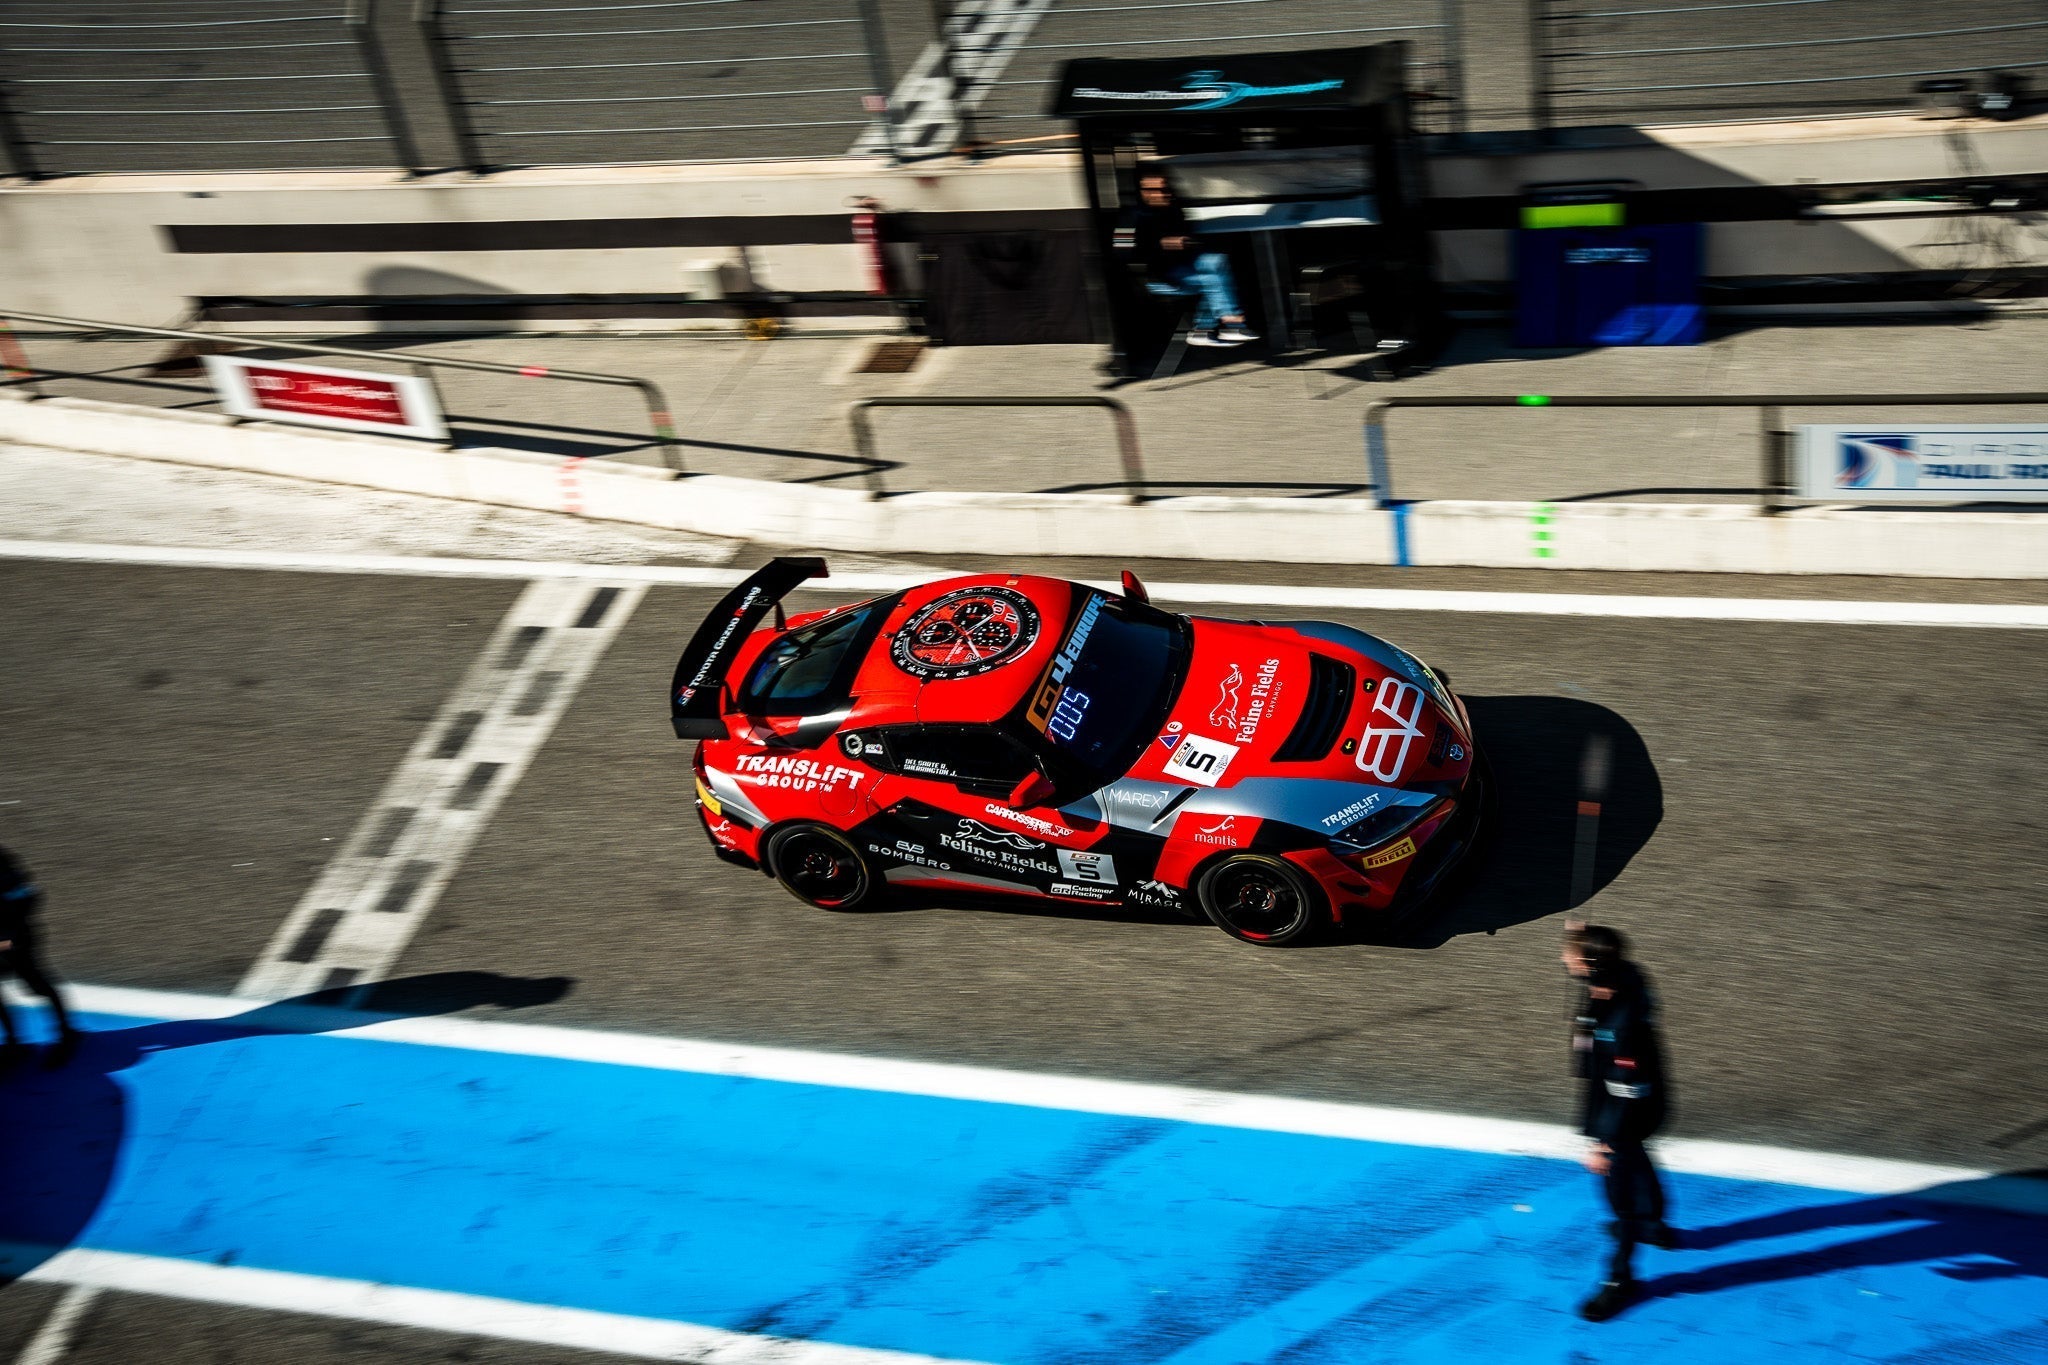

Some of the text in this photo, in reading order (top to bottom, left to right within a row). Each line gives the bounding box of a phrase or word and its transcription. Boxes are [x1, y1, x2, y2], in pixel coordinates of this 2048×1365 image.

[1064, 593, 1106, 662] EUROPE
[1048, 686, 1091, 741] 005
[1235, 658, 1280, 744] Feline Fields
[1184, 750, 1217, 773] 5
[1108, 788, 1163, 809] MAREX
[1194, 832, 1237, 847] mantis
[868, 843, 951, 871] BOMBERG
[940, 833, 1059, 874] Feline Fields
[1367, 839, 1413, 867] PIRELLI
[1075, 863, 1101, 881] 5
[1071, 885, 1115, 894] Customer
[1071, 890, 1104, 900] Racing
